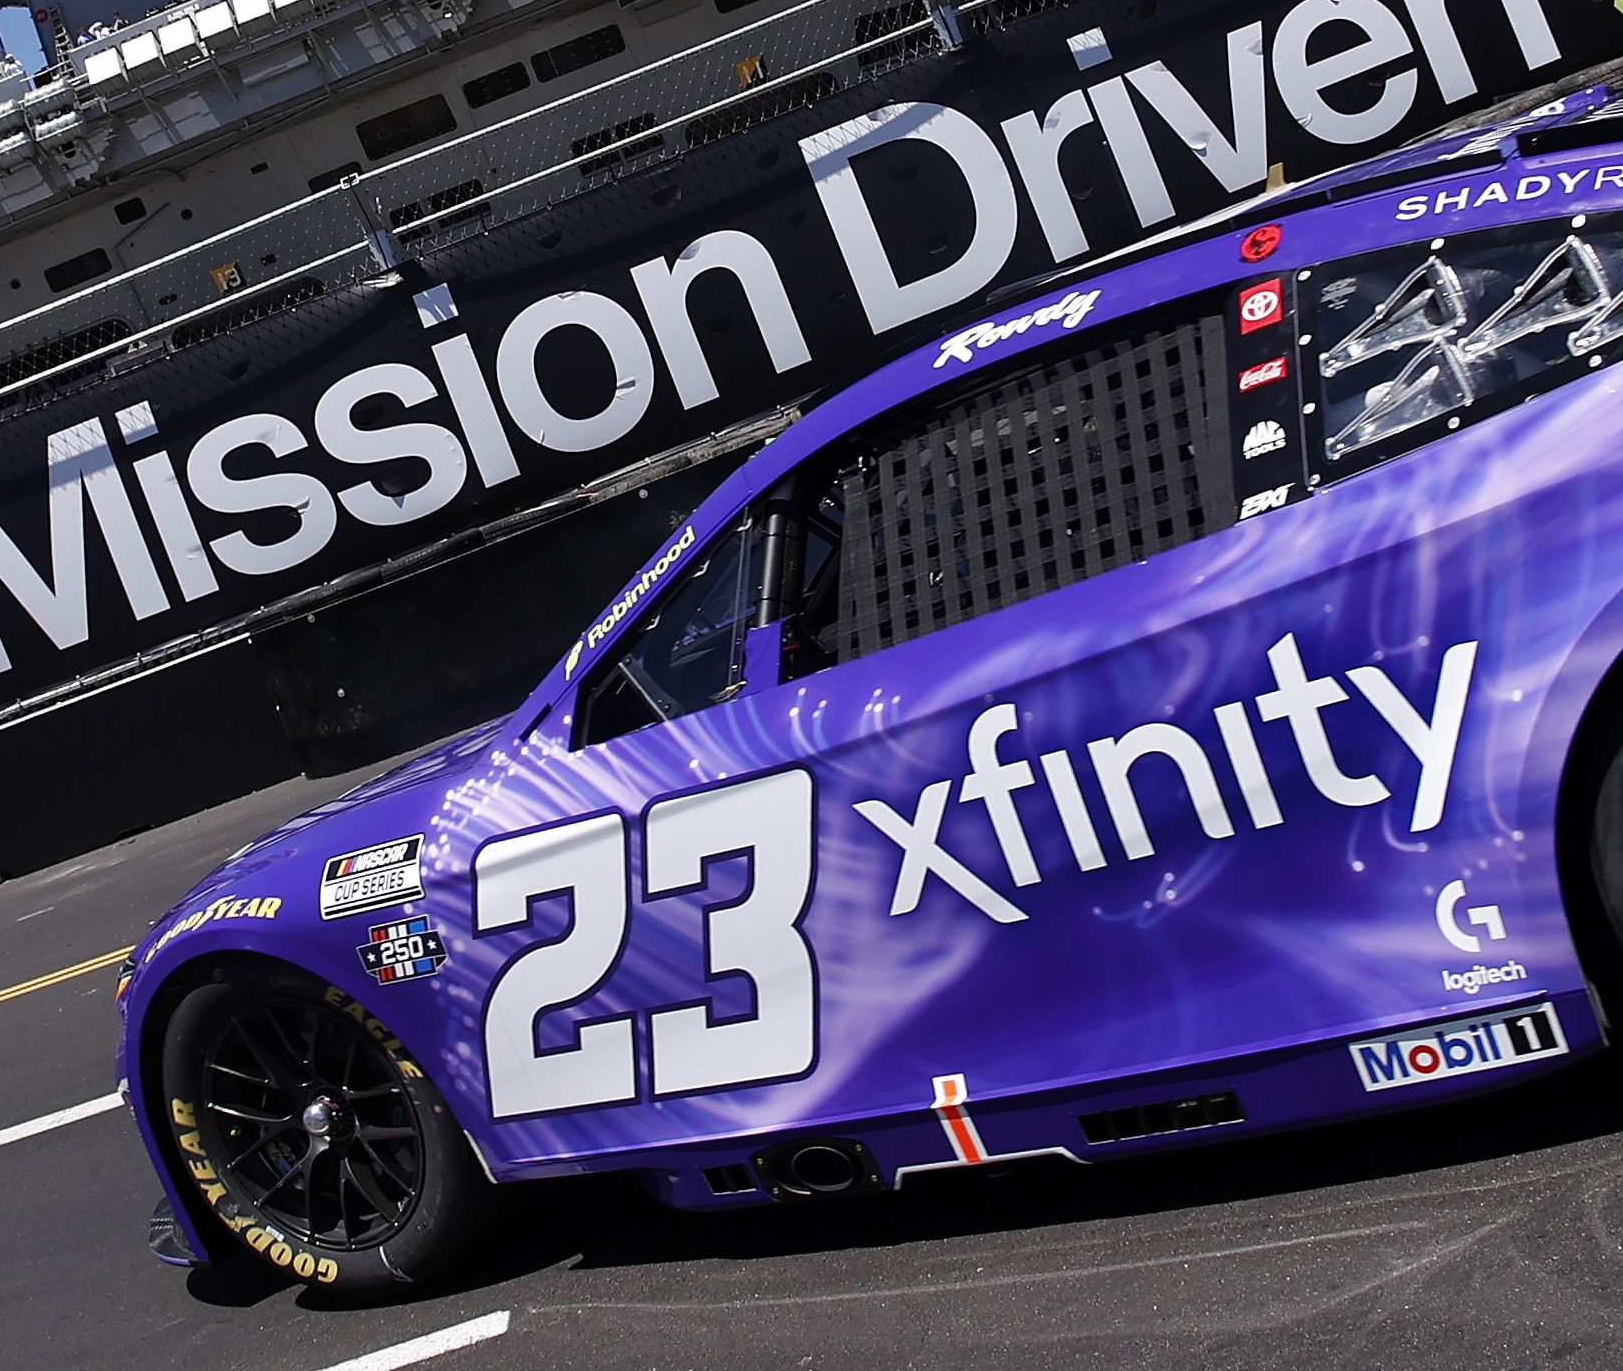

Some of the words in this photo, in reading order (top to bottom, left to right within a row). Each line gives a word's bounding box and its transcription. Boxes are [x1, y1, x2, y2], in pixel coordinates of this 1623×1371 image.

[217, 266, 242, 290] 13
[932, 288, 1102, 370] Rowdy
[1243, 439, 1286, 460] TOOLS
[586, 525, 698, 650] Robinhood
[852, 632, 1479, 925] xfinity
[334, 882, 360, 903] CUP
[362, 870, 405, 898] SERIES
[354, 842, 409, 872] NASCAR
[379, 935, 425, 965] 250
[474, 767, 815, 1120] 23
[1435, 879, 1507, 953] G
[1441, 960, 1528, 995] logitech
[324, 986, 424, 1079] EAGLE
[1362, 1021, 1501, 1087] Mobil
[1516, 1016, 1542, 1050] 1
